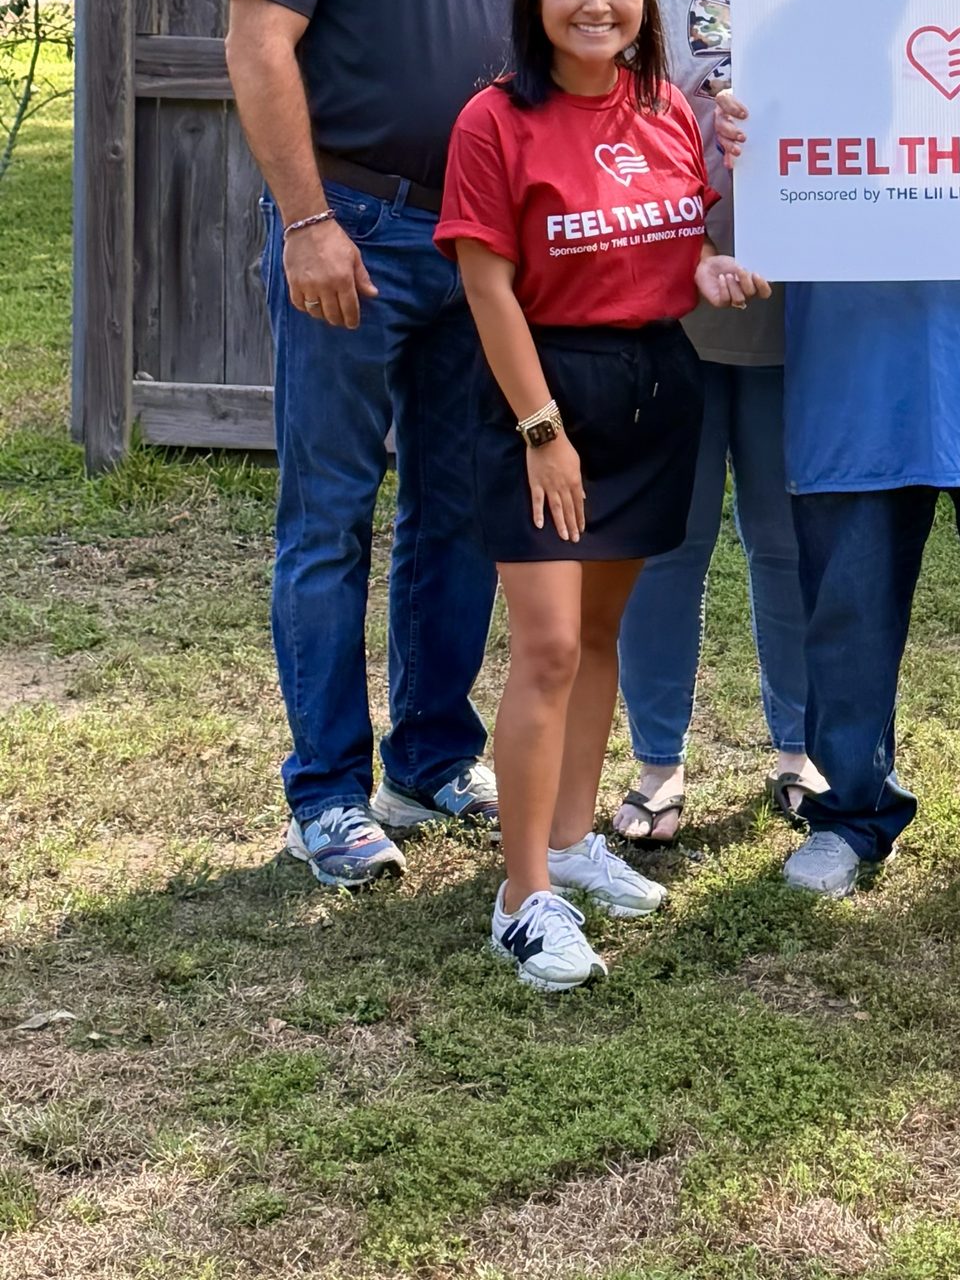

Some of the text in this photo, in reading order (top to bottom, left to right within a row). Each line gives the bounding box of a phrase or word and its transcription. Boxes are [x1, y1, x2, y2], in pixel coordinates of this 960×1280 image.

[779, 137, 890, 176] FEEL
[780, 187, 857, 204] Sponsored
[863, 187, 881, 203] by
[885, 187, 918, 200] THE
[547, 195, 704, 241] FEEL THE LOV
[549, 242, 598, 258] Sponsored
[600, 240, 610, 252] by
[611, 237, 628, 248] THE
[642, 229, 677, 244] LENNOX
